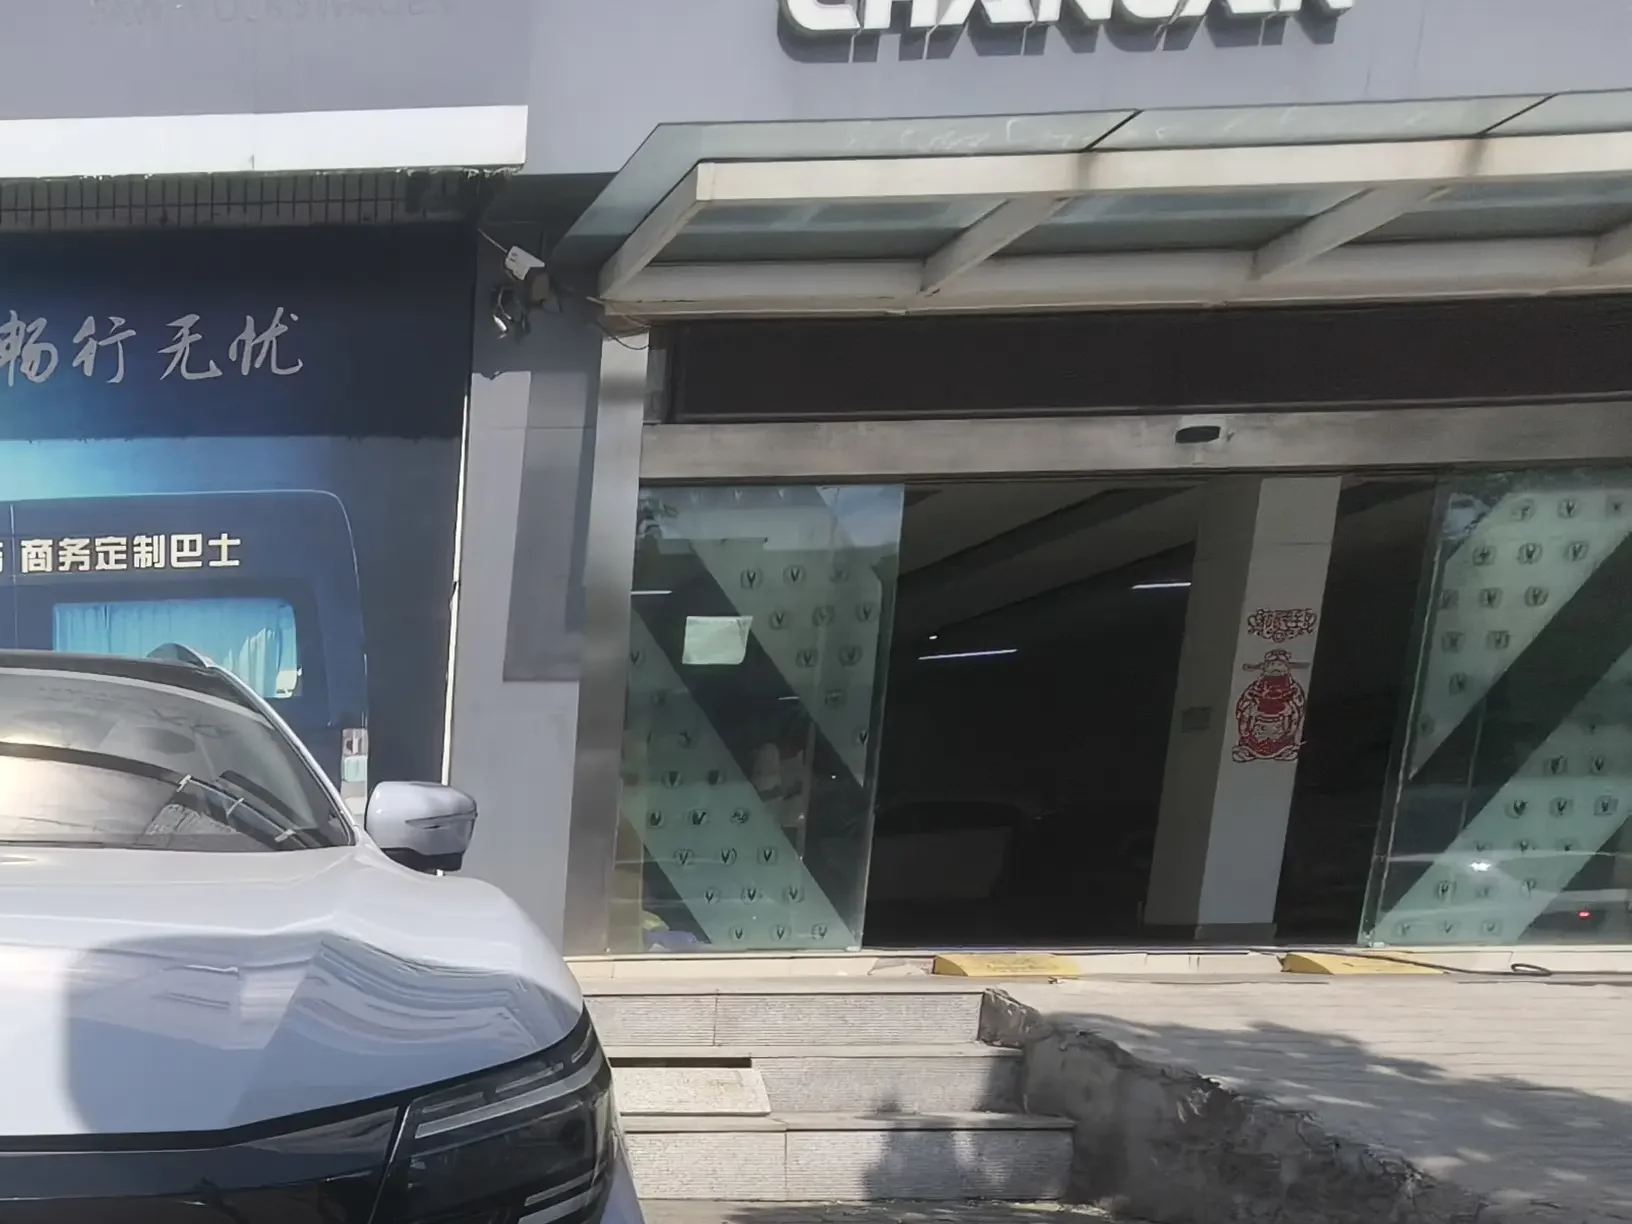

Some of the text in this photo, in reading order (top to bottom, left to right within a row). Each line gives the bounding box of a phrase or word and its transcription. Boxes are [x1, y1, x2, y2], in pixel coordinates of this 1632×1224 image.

[19, 533, 242, 574] 商务定制巴士
